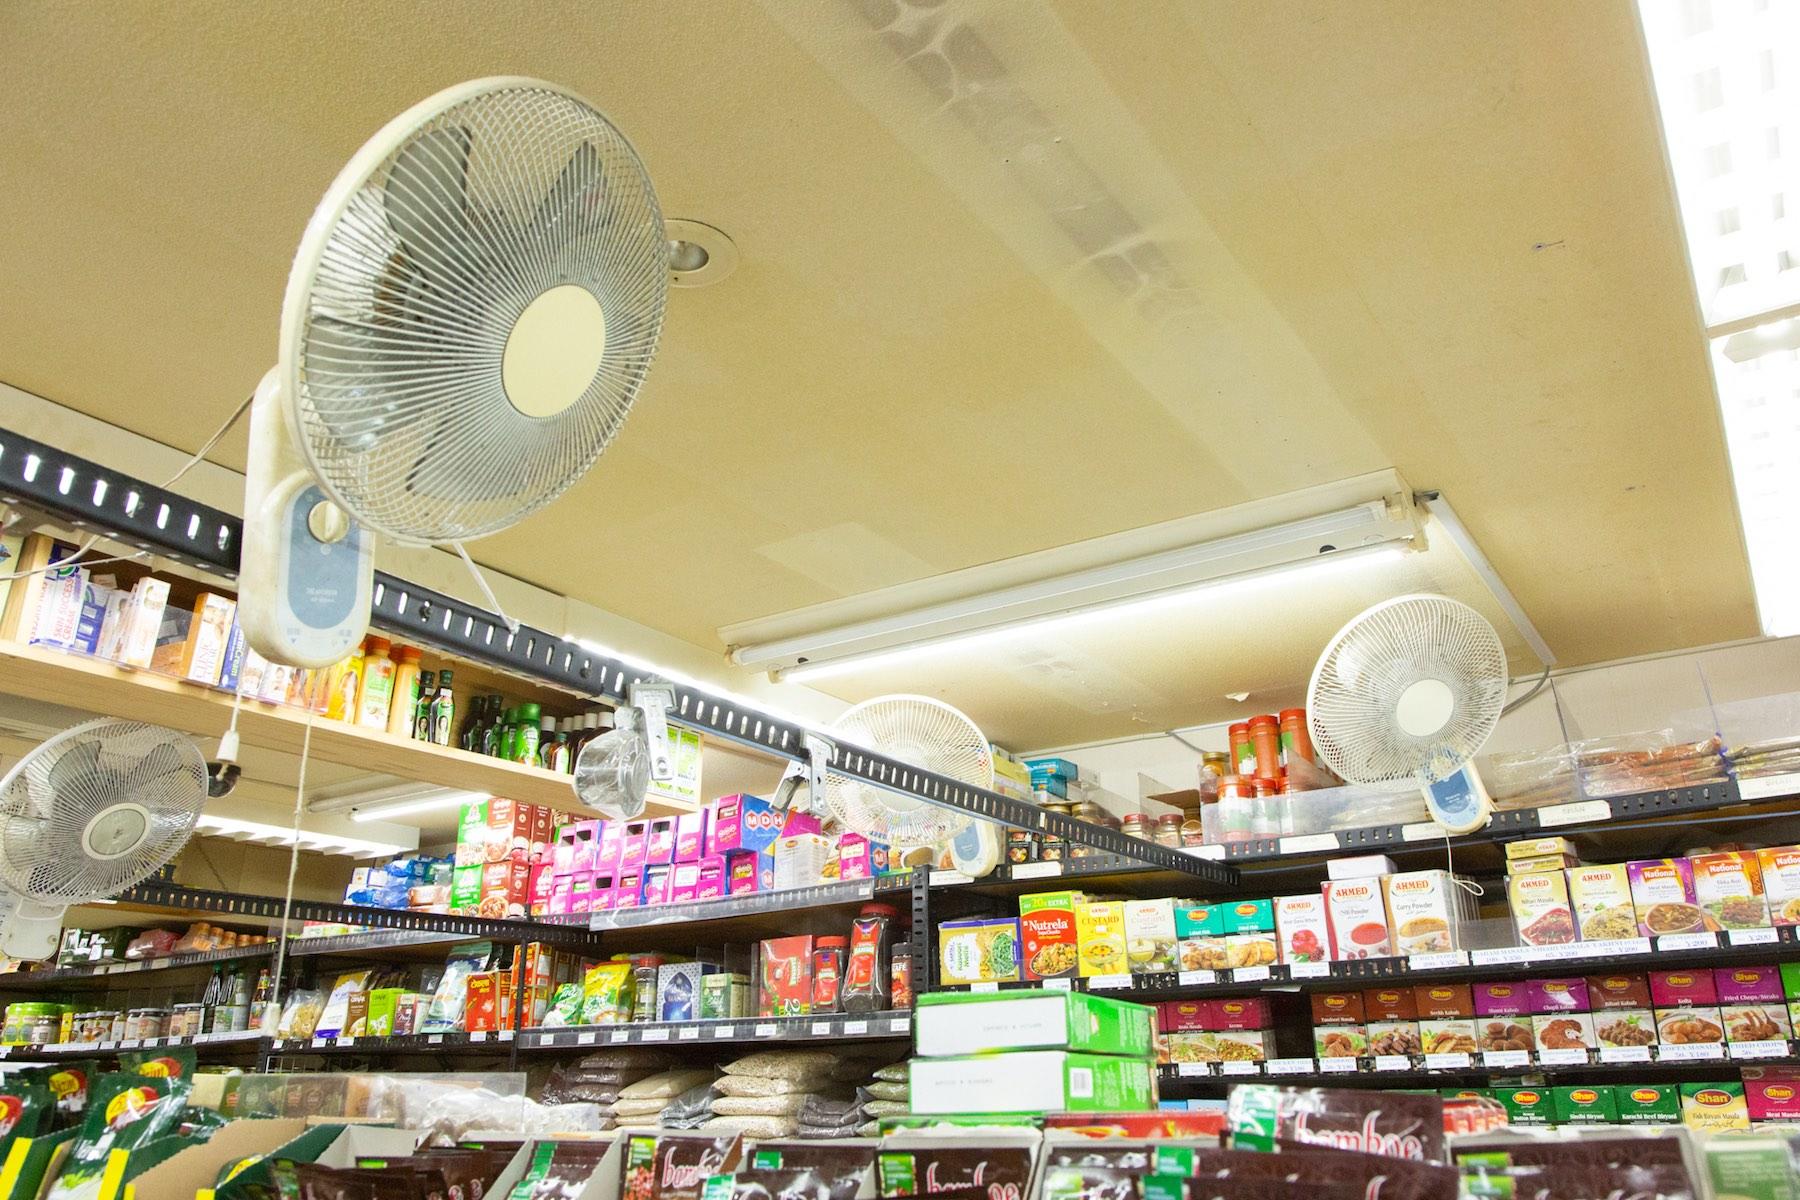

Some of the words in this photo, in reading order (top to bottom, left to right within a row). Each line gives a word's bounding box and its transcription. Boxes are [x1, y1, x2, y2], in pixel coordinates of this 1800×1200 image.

[748, 815, 783, 825] MDH
[1709, 863, 1742, 873] National
[1582, 873, 1611, 882] AHMED
[1643, 869, 1675, 879] National
[1396, 880, 1429, 890] AHMED
[1520, 880, 1549, 889] AHMED
[1335, 886, 1368, 897] AHMED
[1286, 901, 1311, 910] AHMED
[1396, 903, 1411, 911] Curry
[1029, 919, 1068, 931] Nutrela
[1082, 917, 1120, 926] CUSTARD
[1669, 976, 1693, 985] Shan
[1736, 973, 1759, 982] Shan
[1545, 983, 1567, 992] Shan
[1606, 980, 1629, 988] Shan
[1431, 989, 1453, 998] Shan
[1489, 988, 1511, 996] Shan
[1326, 997, 1345, 1006] Shan
[1380, 993, 1399, 1001] Shan
[1573, 1092, 1596, 1100] Shan
[1633, 1092, 1657, 1100] Shan
[1767, 1088, 1792, 1097] Shan
[1515, 1094, 1538, 1102] Shan
[1696, 1093, 1728, 1103] Shan
[1586, 1113, 1605, 1121] Biryani
[1657, 1113, 1677, 1121] Biryani
